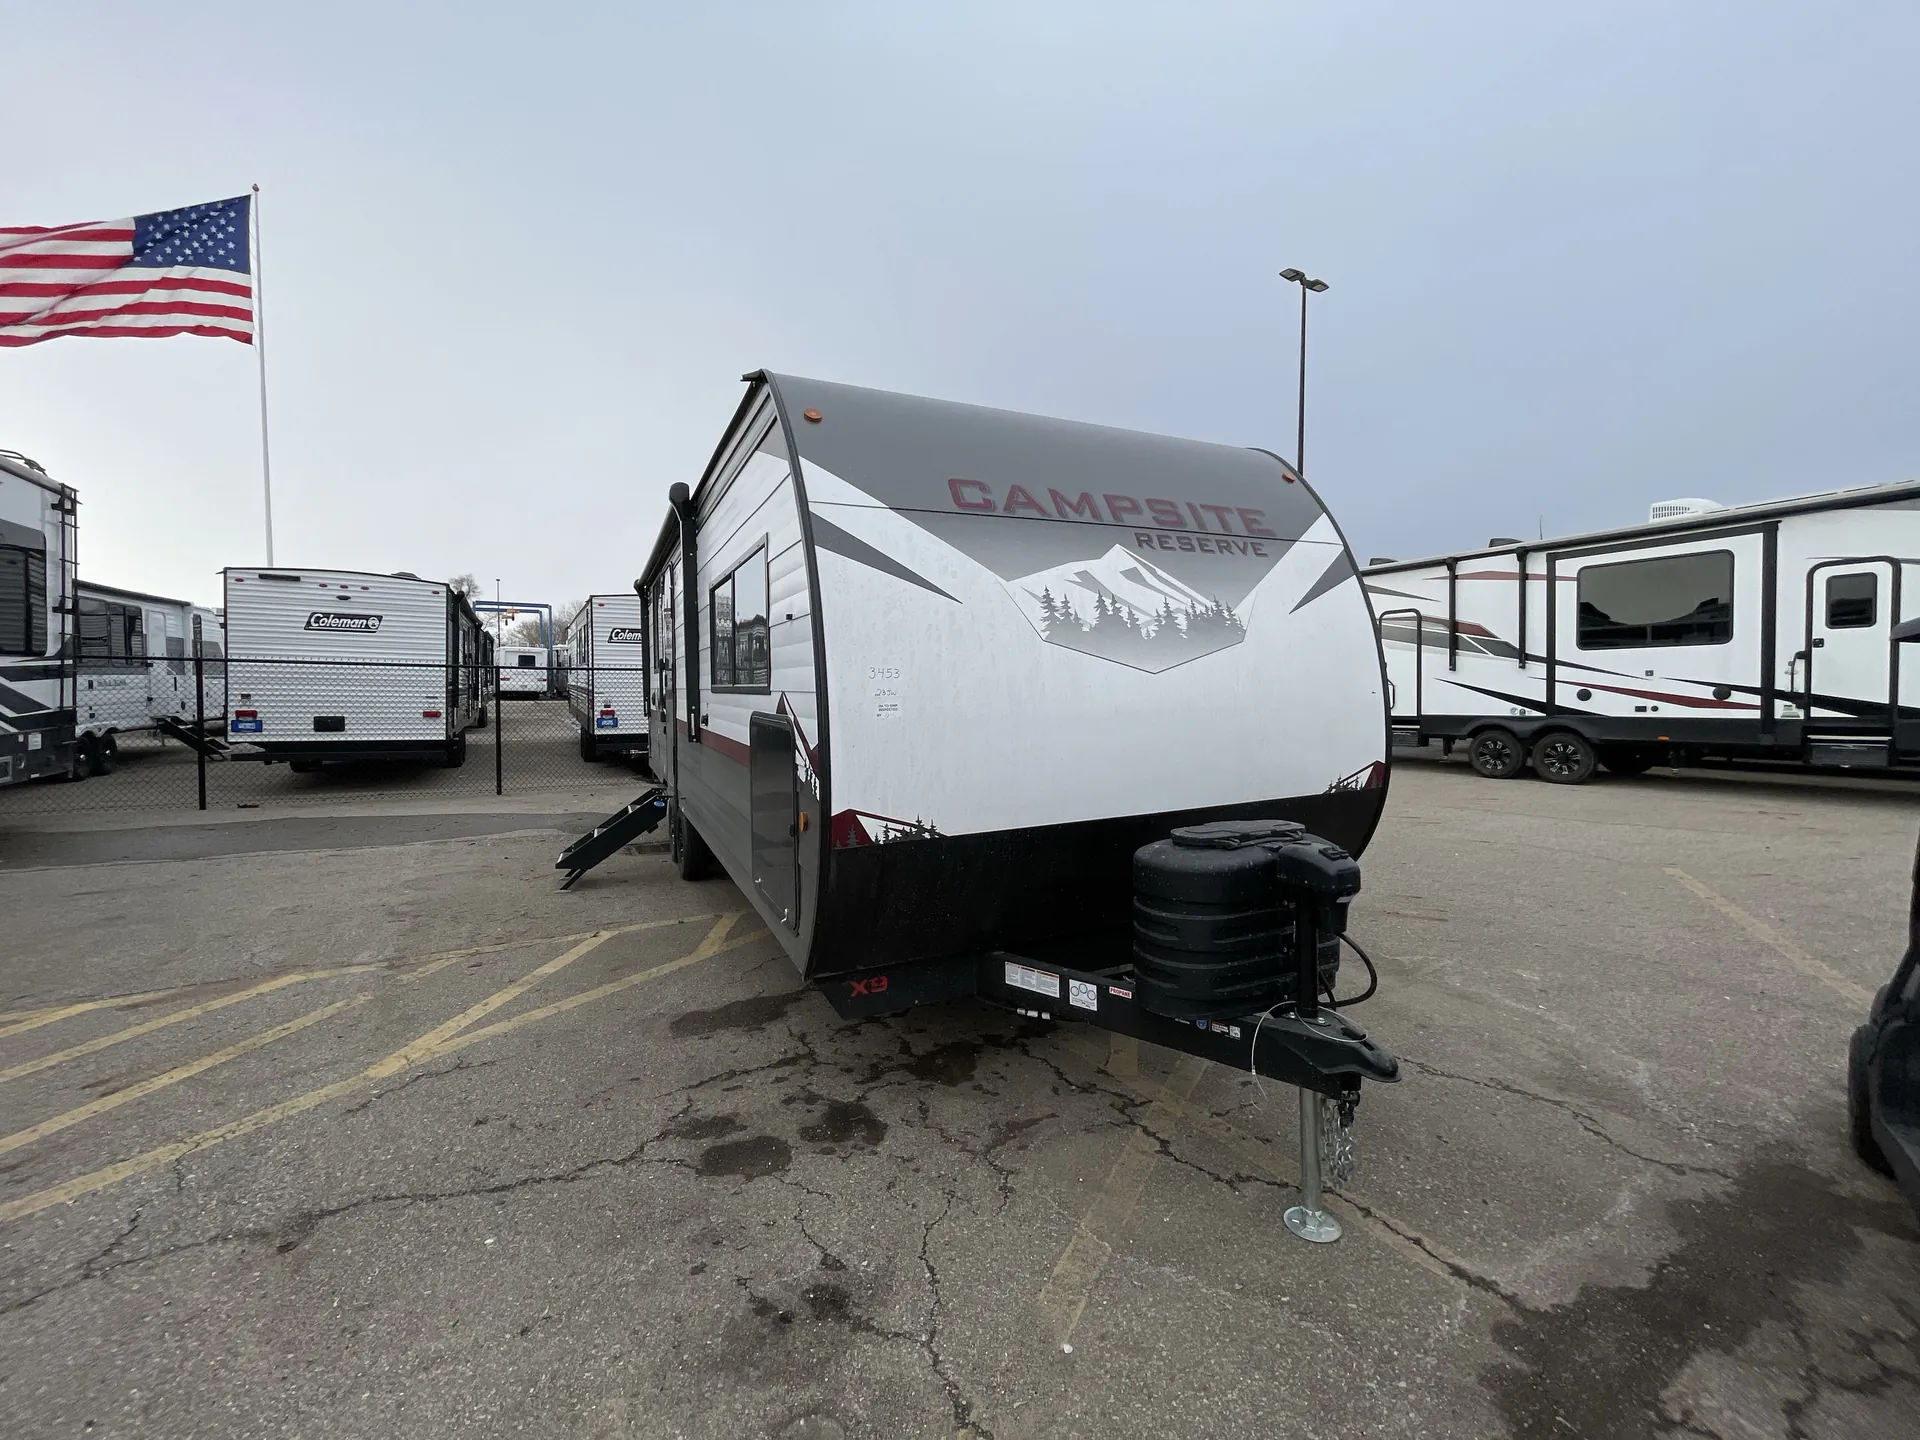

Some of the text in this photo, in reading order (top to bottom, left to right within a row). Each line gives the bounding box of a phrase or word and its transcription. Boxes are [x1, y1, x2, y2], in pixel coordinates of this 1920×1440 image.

[947, 478, 1276, 537] CAMPSITE
[1132, 531, 1269, 558] RESERVE
[310, 613, 367, 628] Coleman
[611, 628, 642, 640] Colem
[868, 666, 901, 680] 3453
[848, 976, 888, 997] X9
[1110, 987, 1131, 998] PROPANE
